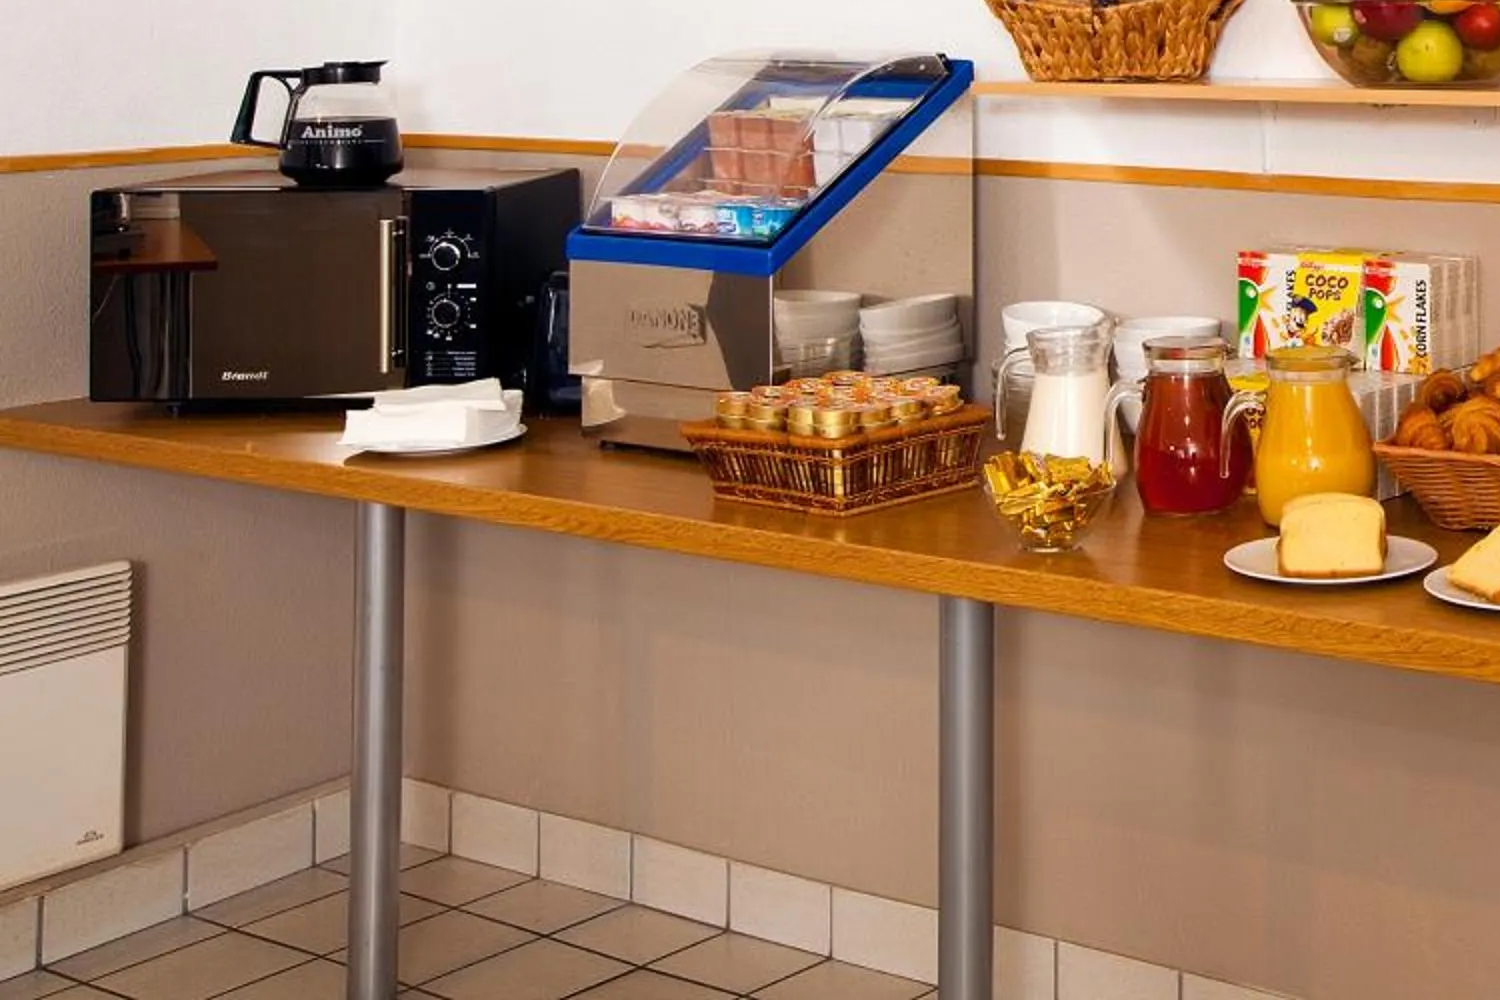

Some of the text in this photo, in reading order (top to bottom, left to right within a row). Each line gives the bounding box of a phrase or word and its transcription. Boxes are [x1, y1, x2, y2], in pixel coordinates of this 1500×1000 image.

[301, 125, 362, 138] Animo
[1305, 273, 1349, 289] COCO
[1309, 287, 1342, 301] POPS
[1415, 280, 1427, 358] CORN FLAKES
